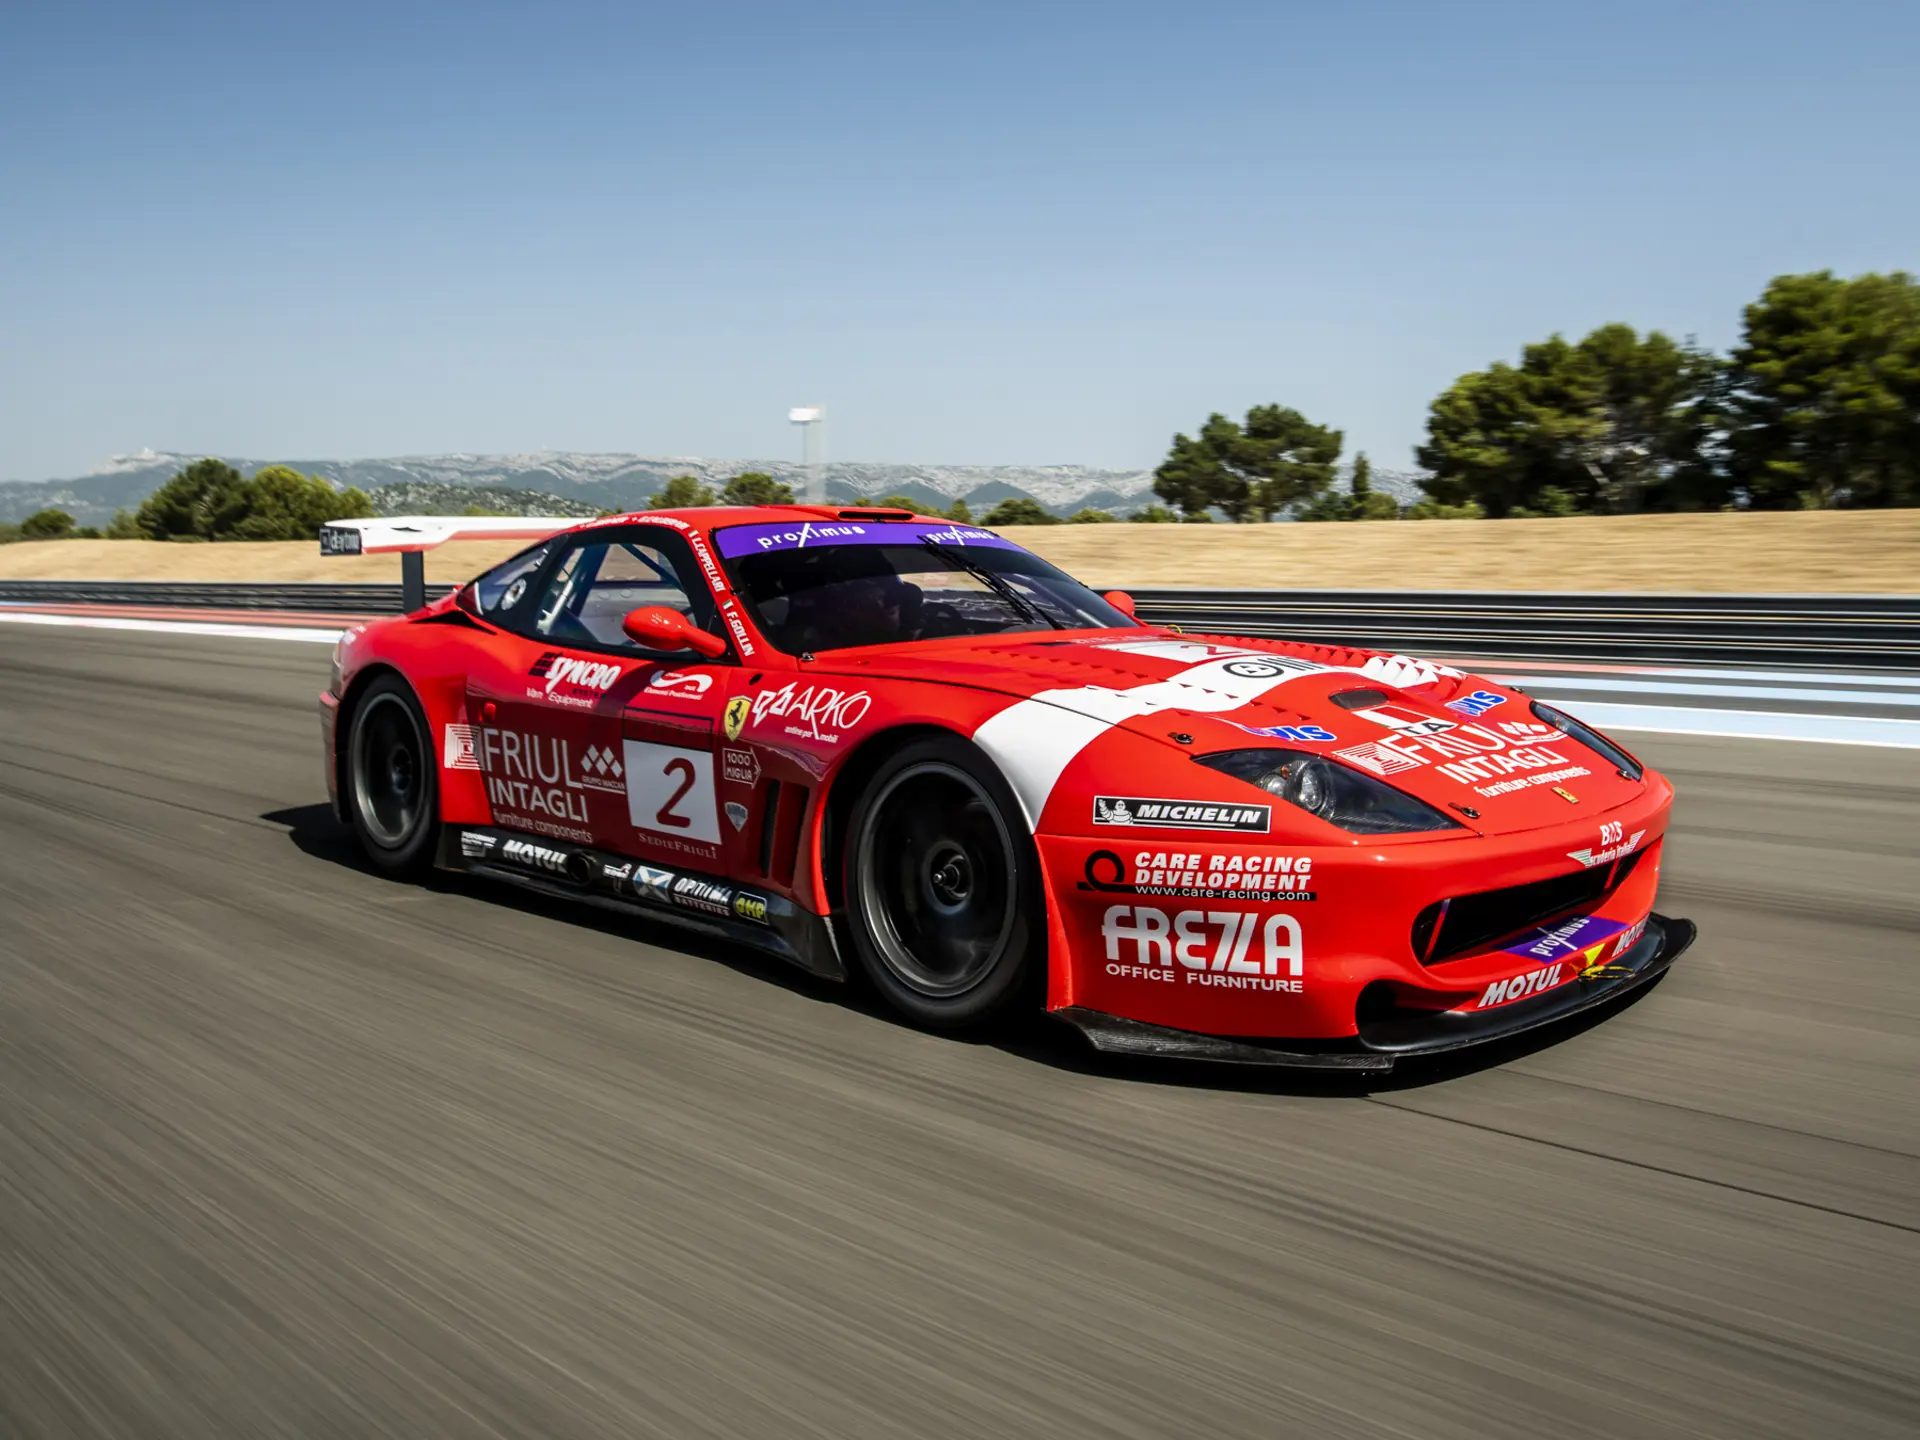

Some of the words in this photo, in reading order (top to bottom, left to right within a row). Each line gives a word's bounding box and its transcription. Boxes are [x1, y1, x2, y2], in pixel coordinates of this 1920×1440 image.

[757, 522, 866, 548] proximus
[726, 610, 756, 657] F.GOLLIN
[545, 656, 622, 694] SYNCRO
[548, 691, 594, 708] Equipment
[483, 728, 584, 789] FRIUL
[727, 752, 750, 766] 1000
[1378, 722, 1530, 765] FRIUL
[726, 767, 753, 781] MIGLIA
[1434, 746, 1570, 784] INTAGLI
[1473, 778, 1531, 798] furniture
[1529, 765, 1592, 786] components
[488, 776, 589, 823] INTAGLI
[656, 757, 696, 829] 2
[493, 808, 533, 828] furniture
[534, 818, 594, 844] components
[1136, 804, 1261, 824] MICHELIN
[502, 838, 570, 873] MOTUL
[1135, 852, 1202, 870] CARE
[1209, 856, 1312, 873] RACING
[1135, 870, 1311, 890] DEVELOPMENT
[1135, 885, 1311, 902] www.care-racing.com
[1102, 905, 1303, 976] FREZZA
[1529, 917, 1591, 957] proximus
[1105, 963, 1175, 982] OFFICE
[1186, 972, 1304, 993] FURNITURE
[1477, 963, 1562, 1009] MOTUL
